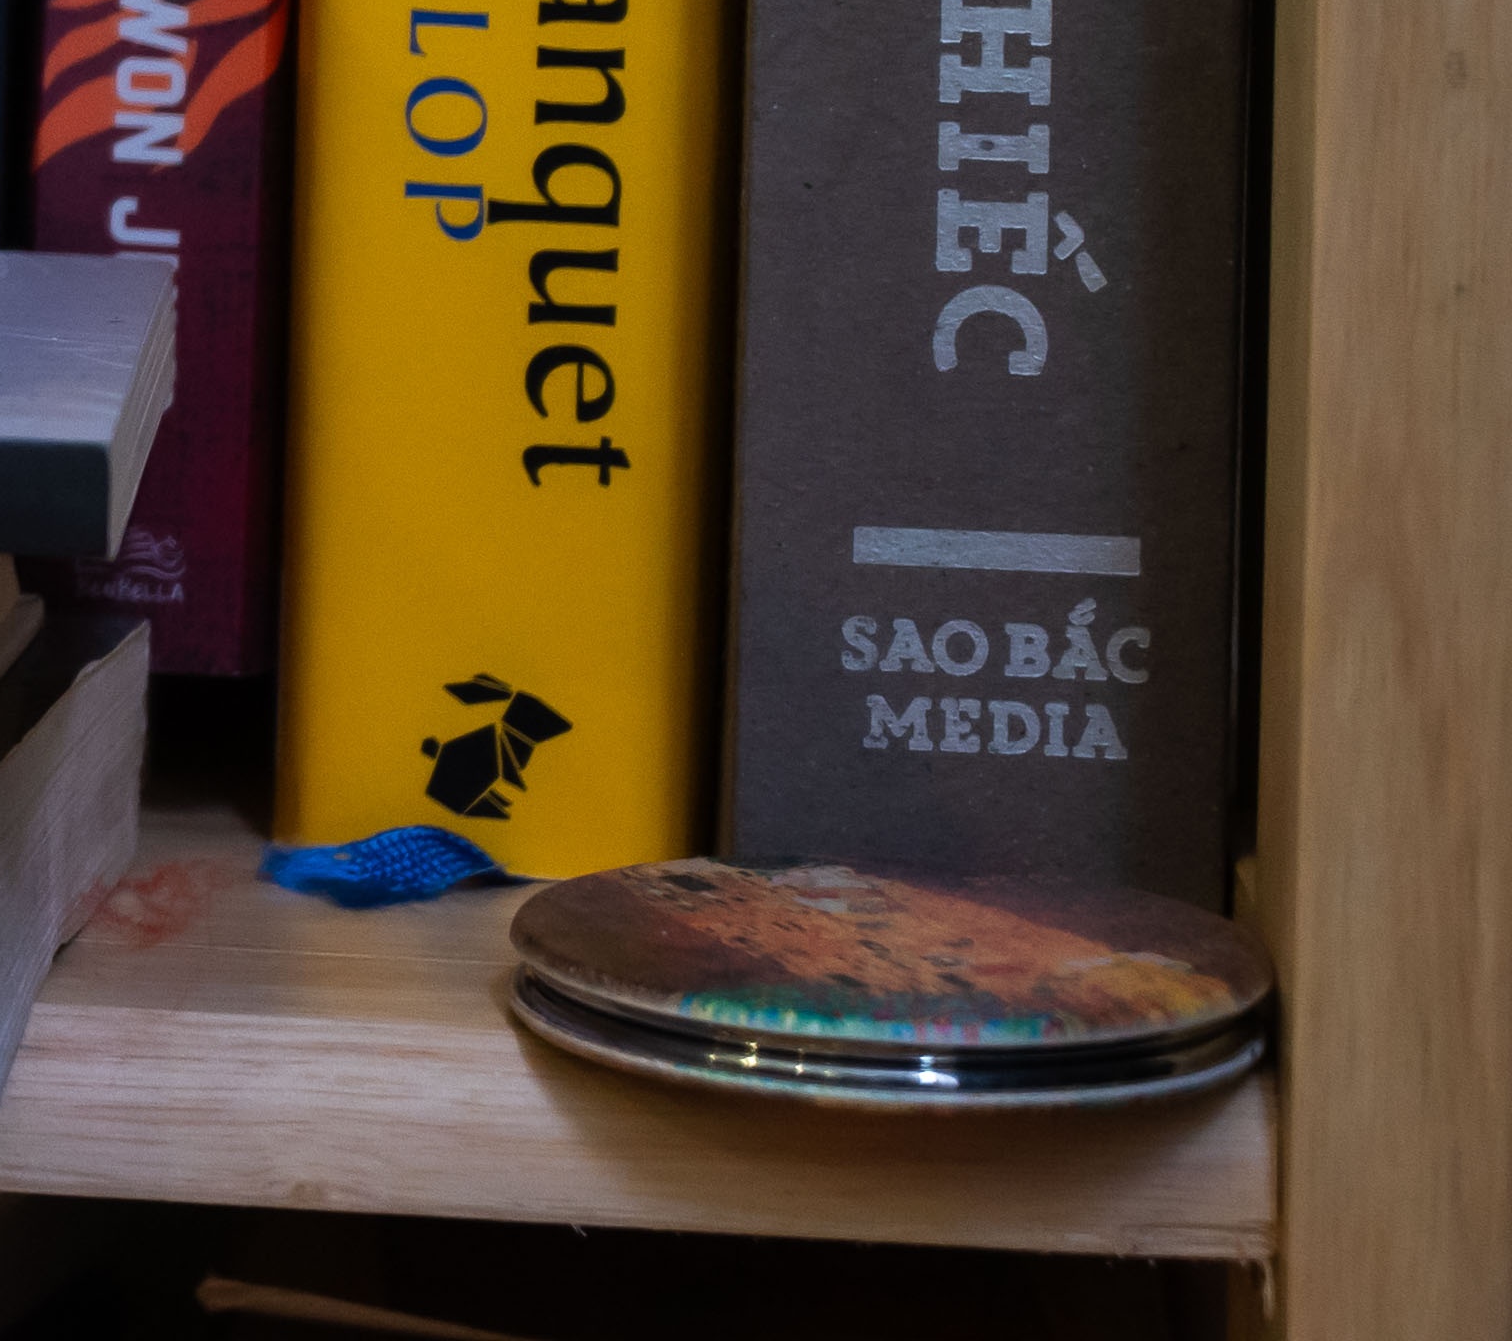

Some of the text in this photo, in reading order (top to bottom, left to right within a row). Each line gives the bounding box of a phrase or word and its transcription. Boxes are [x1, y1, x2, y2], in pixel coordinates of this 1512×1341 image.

[841, 598, 1151, 684] SAO BẮC
[863, 693, 1130, 762] MEDIA
